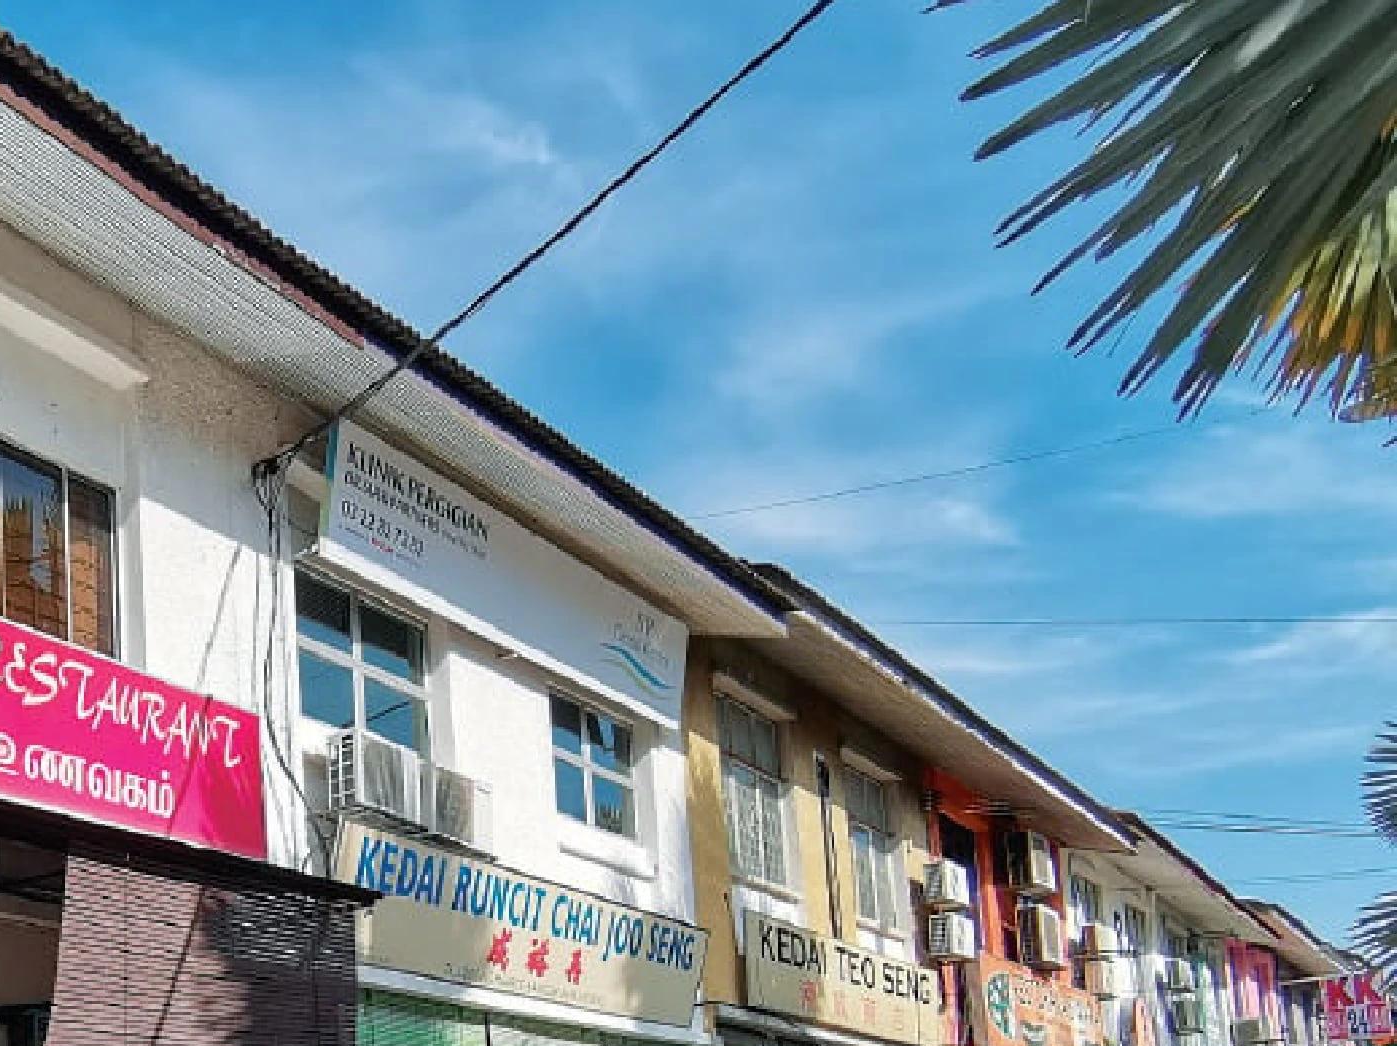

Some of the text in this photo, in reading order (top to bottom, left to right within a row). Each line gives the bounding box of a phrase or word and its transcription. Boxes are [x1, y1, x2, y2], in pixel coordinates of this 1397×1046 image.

[347, 441, 406, 496] KLINIK
[407, 475, 490, 543] PERGIGIAN
[355, 835, 696, 971] KEDAI RUNCIT CHAI JOO SENG
[758, 919, 827, 975] KEDAI
[834, 946, 876, 989] TEO
[882, 963, 930, 1005] SENG
